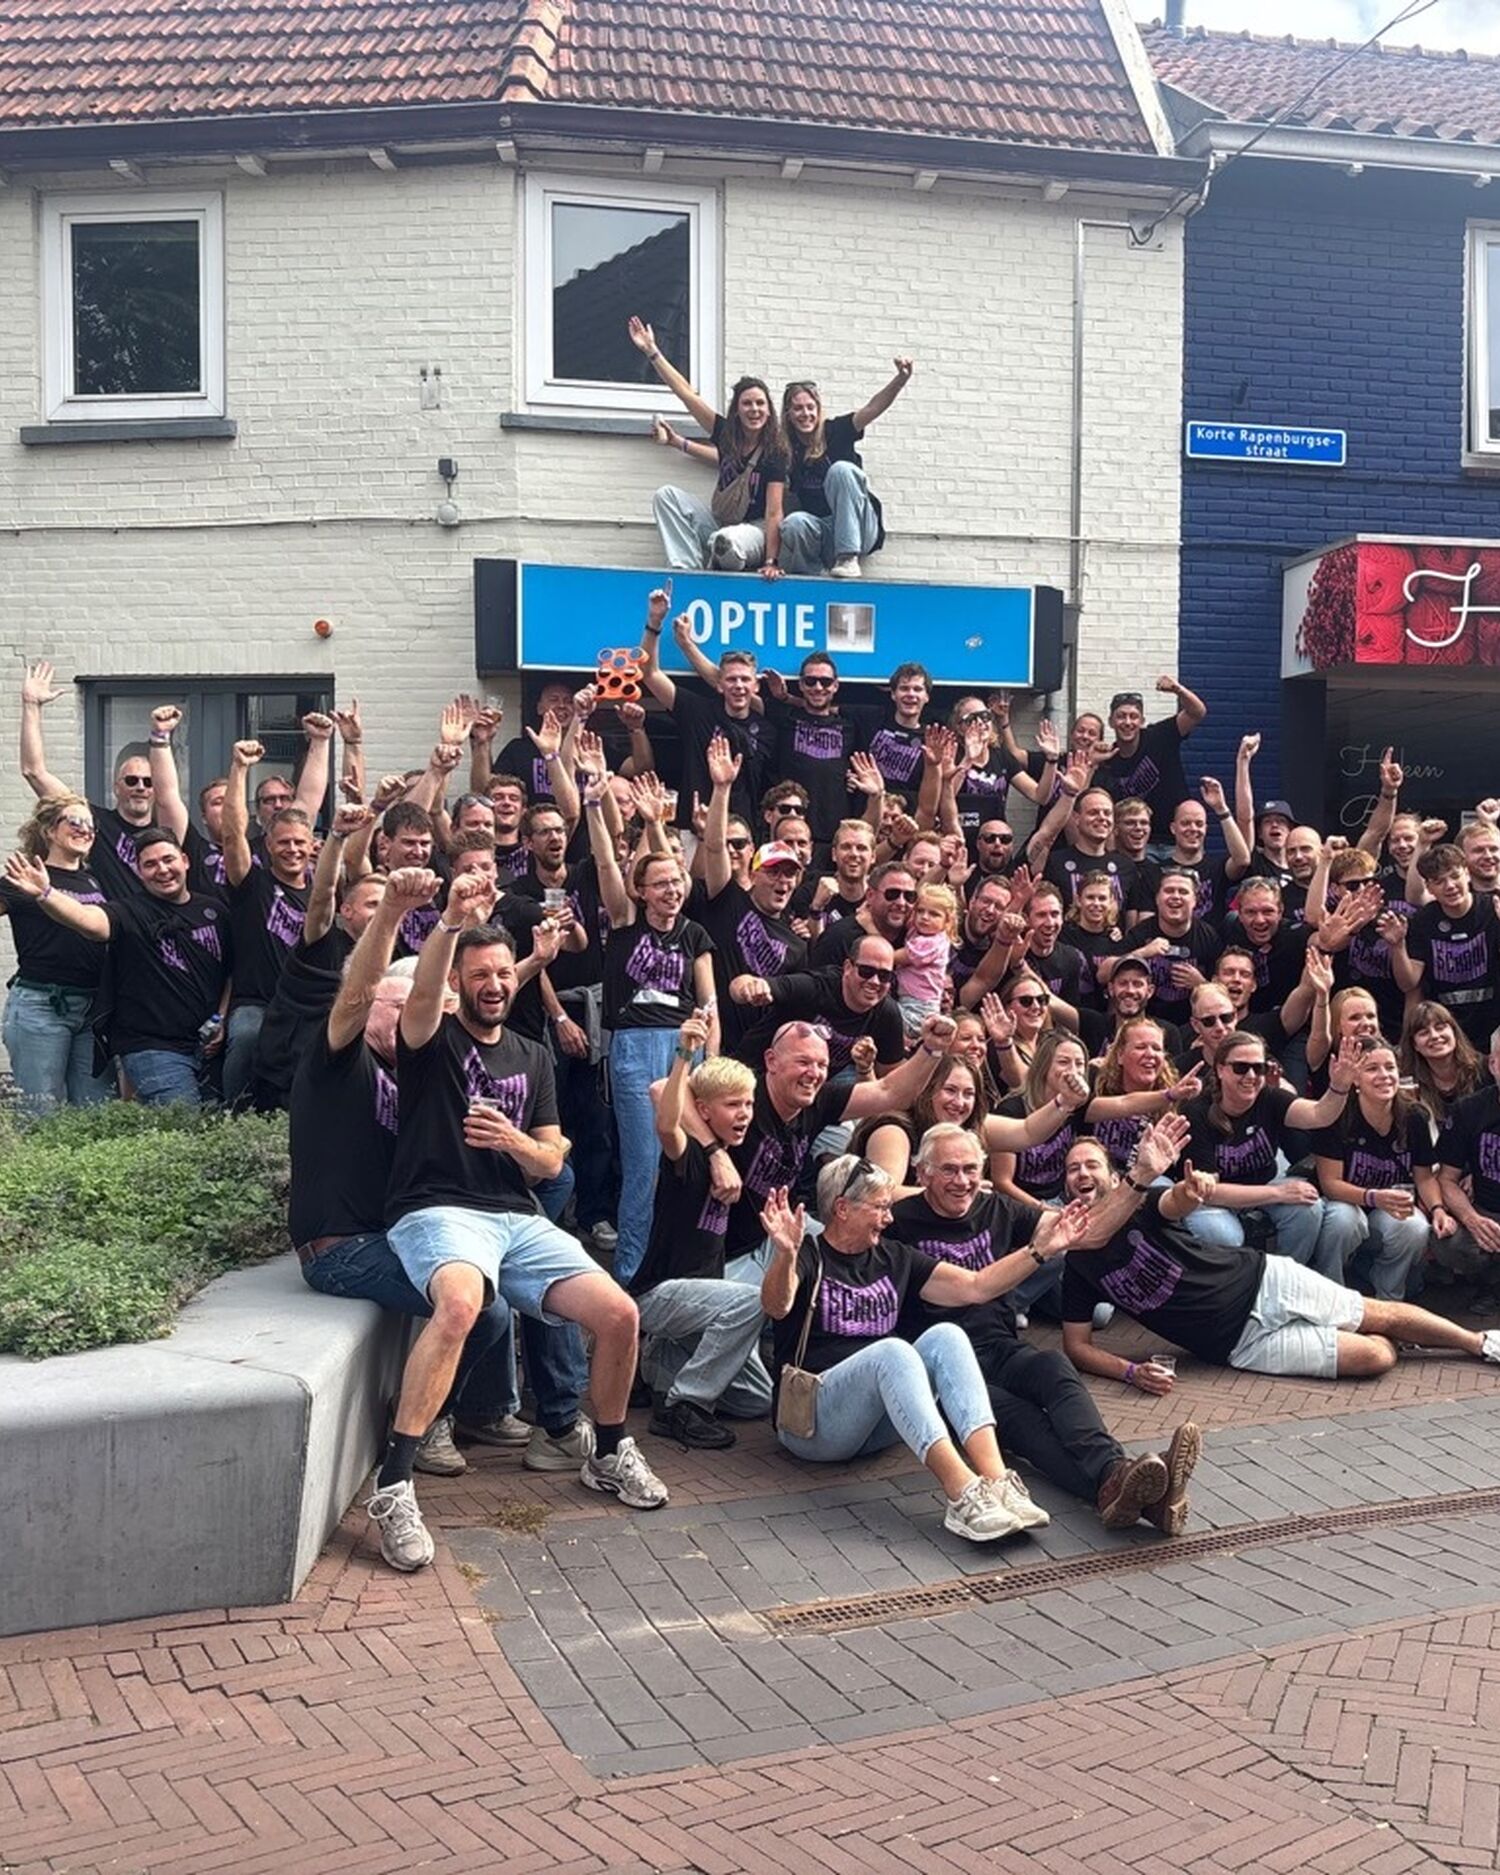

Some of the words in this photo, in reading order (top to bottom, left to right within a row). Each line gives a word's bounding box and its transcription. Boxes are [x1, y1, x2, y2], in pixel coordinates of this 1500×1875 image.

[1196, 427, 1235, 441] Korte
[1240, 429, 1336, 449] Rapenburgse-
[1245, 444, 1288, 458] straat
[687, 598, 815, 648] OPTIE
